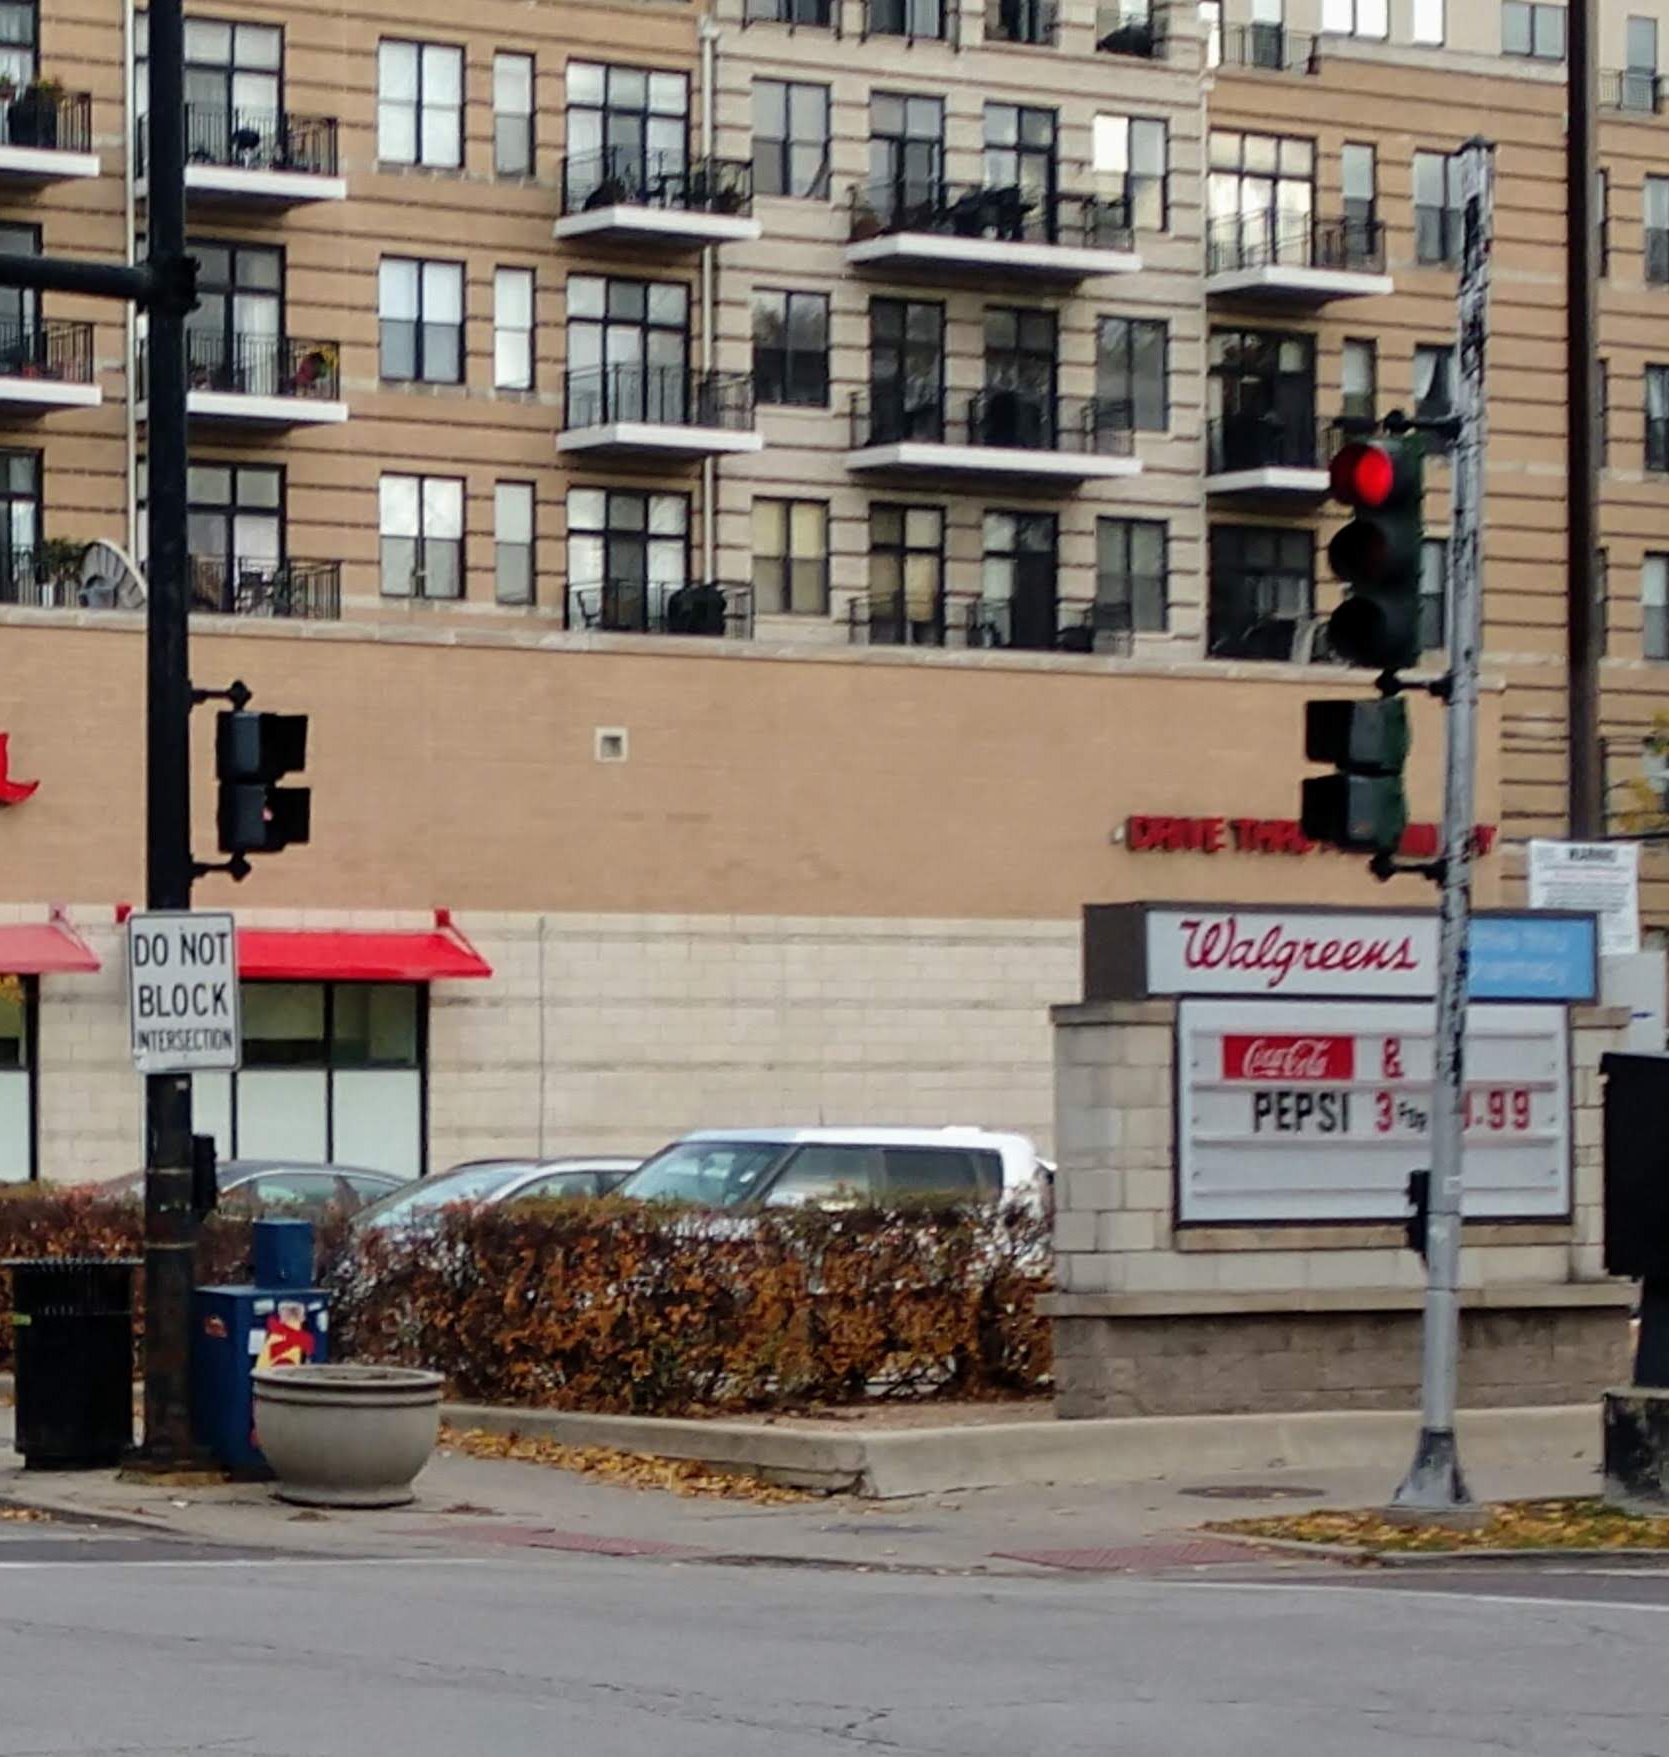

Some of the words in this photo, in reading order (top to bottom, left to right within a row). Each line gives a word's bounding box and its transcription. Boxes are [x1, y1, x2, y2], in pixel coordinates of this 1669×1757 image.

[134, 933, 168, 967] DO
[180, 932, 228, 965] NOT
[1180, 919, 1419, 988] Walgreens
[138, 983, 228, 1017] BLOCK
[1383, 1038, 1405, 1078] &
[1253, 1091, 1349, 1133] PEPSI
[1375, 1090, 1393, 1132] 3
